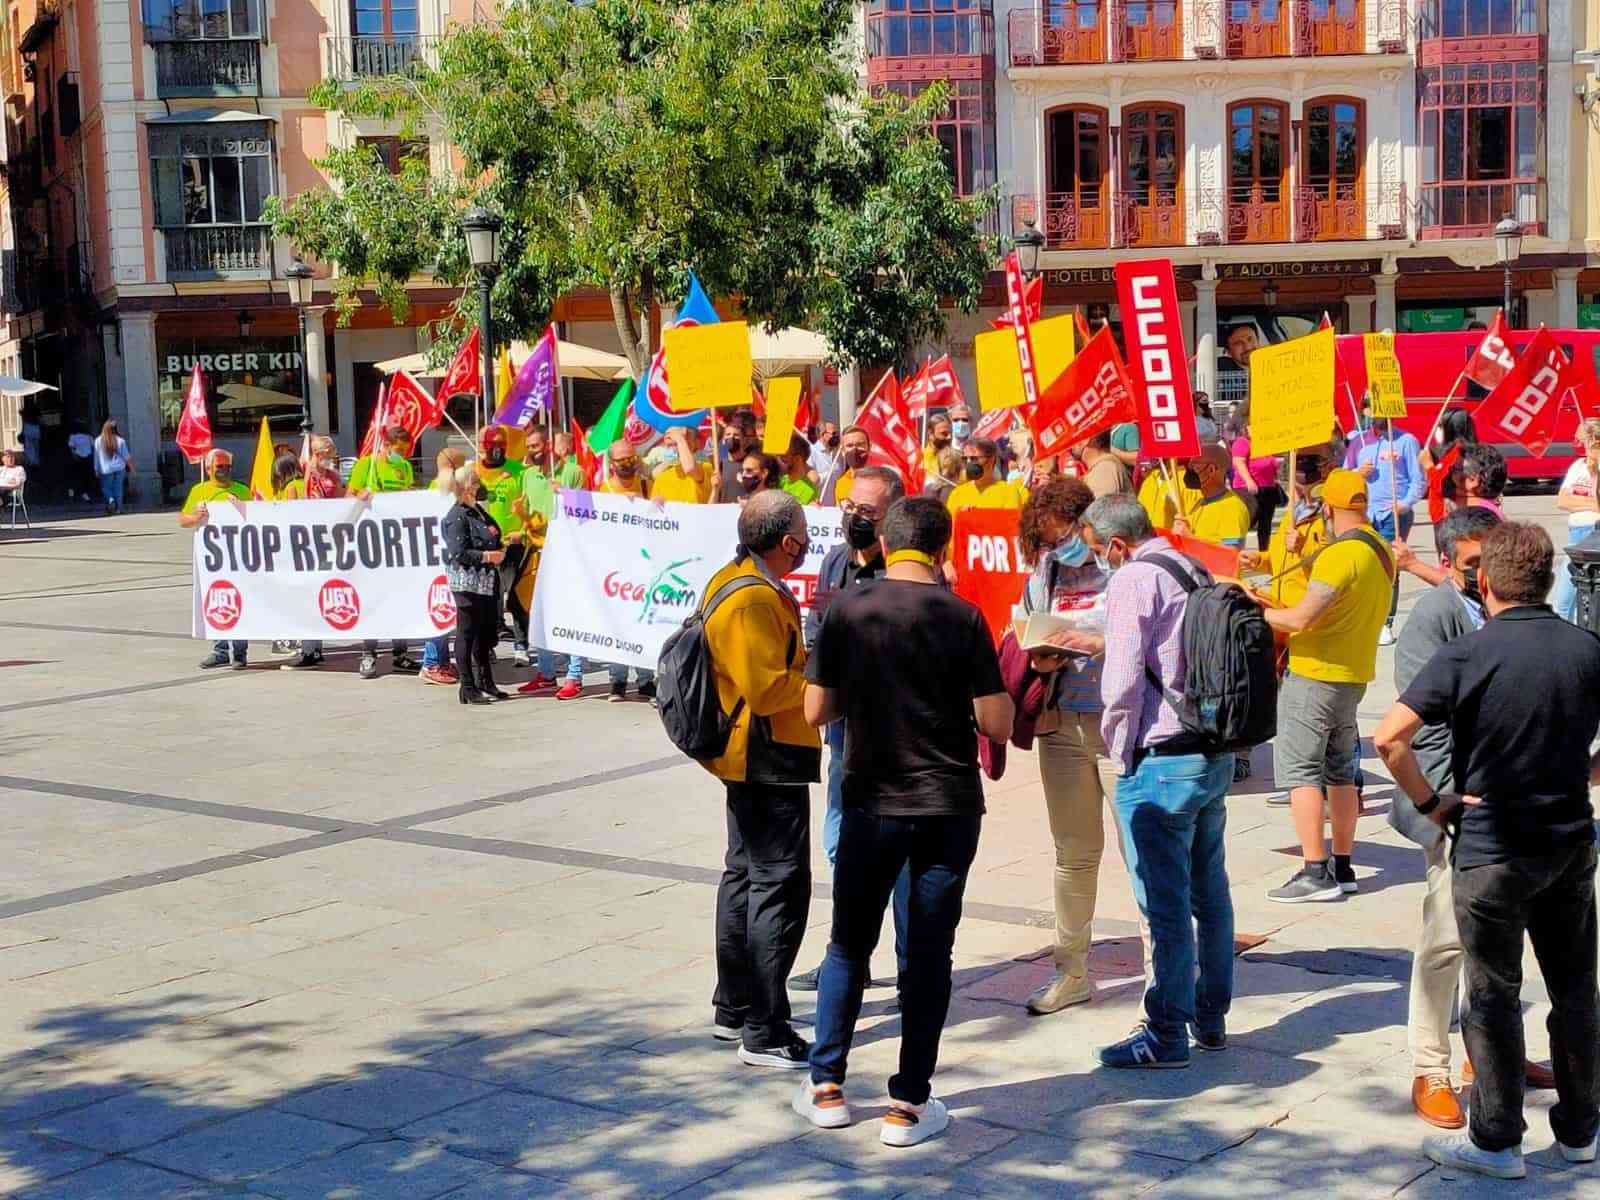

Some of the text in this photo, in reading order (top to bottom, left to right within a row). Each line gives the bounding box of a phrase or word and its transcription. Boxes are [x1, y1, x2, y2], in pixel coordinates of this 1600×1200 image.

[1048, 270, 1096, 283] HOTEL
[1240, 263, 1304, 276] ADOLFO
[1131, 275, 1178, 417] CCOO
[167, 351, 306, 373] BURGER KIN
[601, 511, 618, 523] DE
[203, 524, 281, 573] STOP
[967, 534, 1011, 573] POR
[551, 626, 613, 647] CONVENIO
